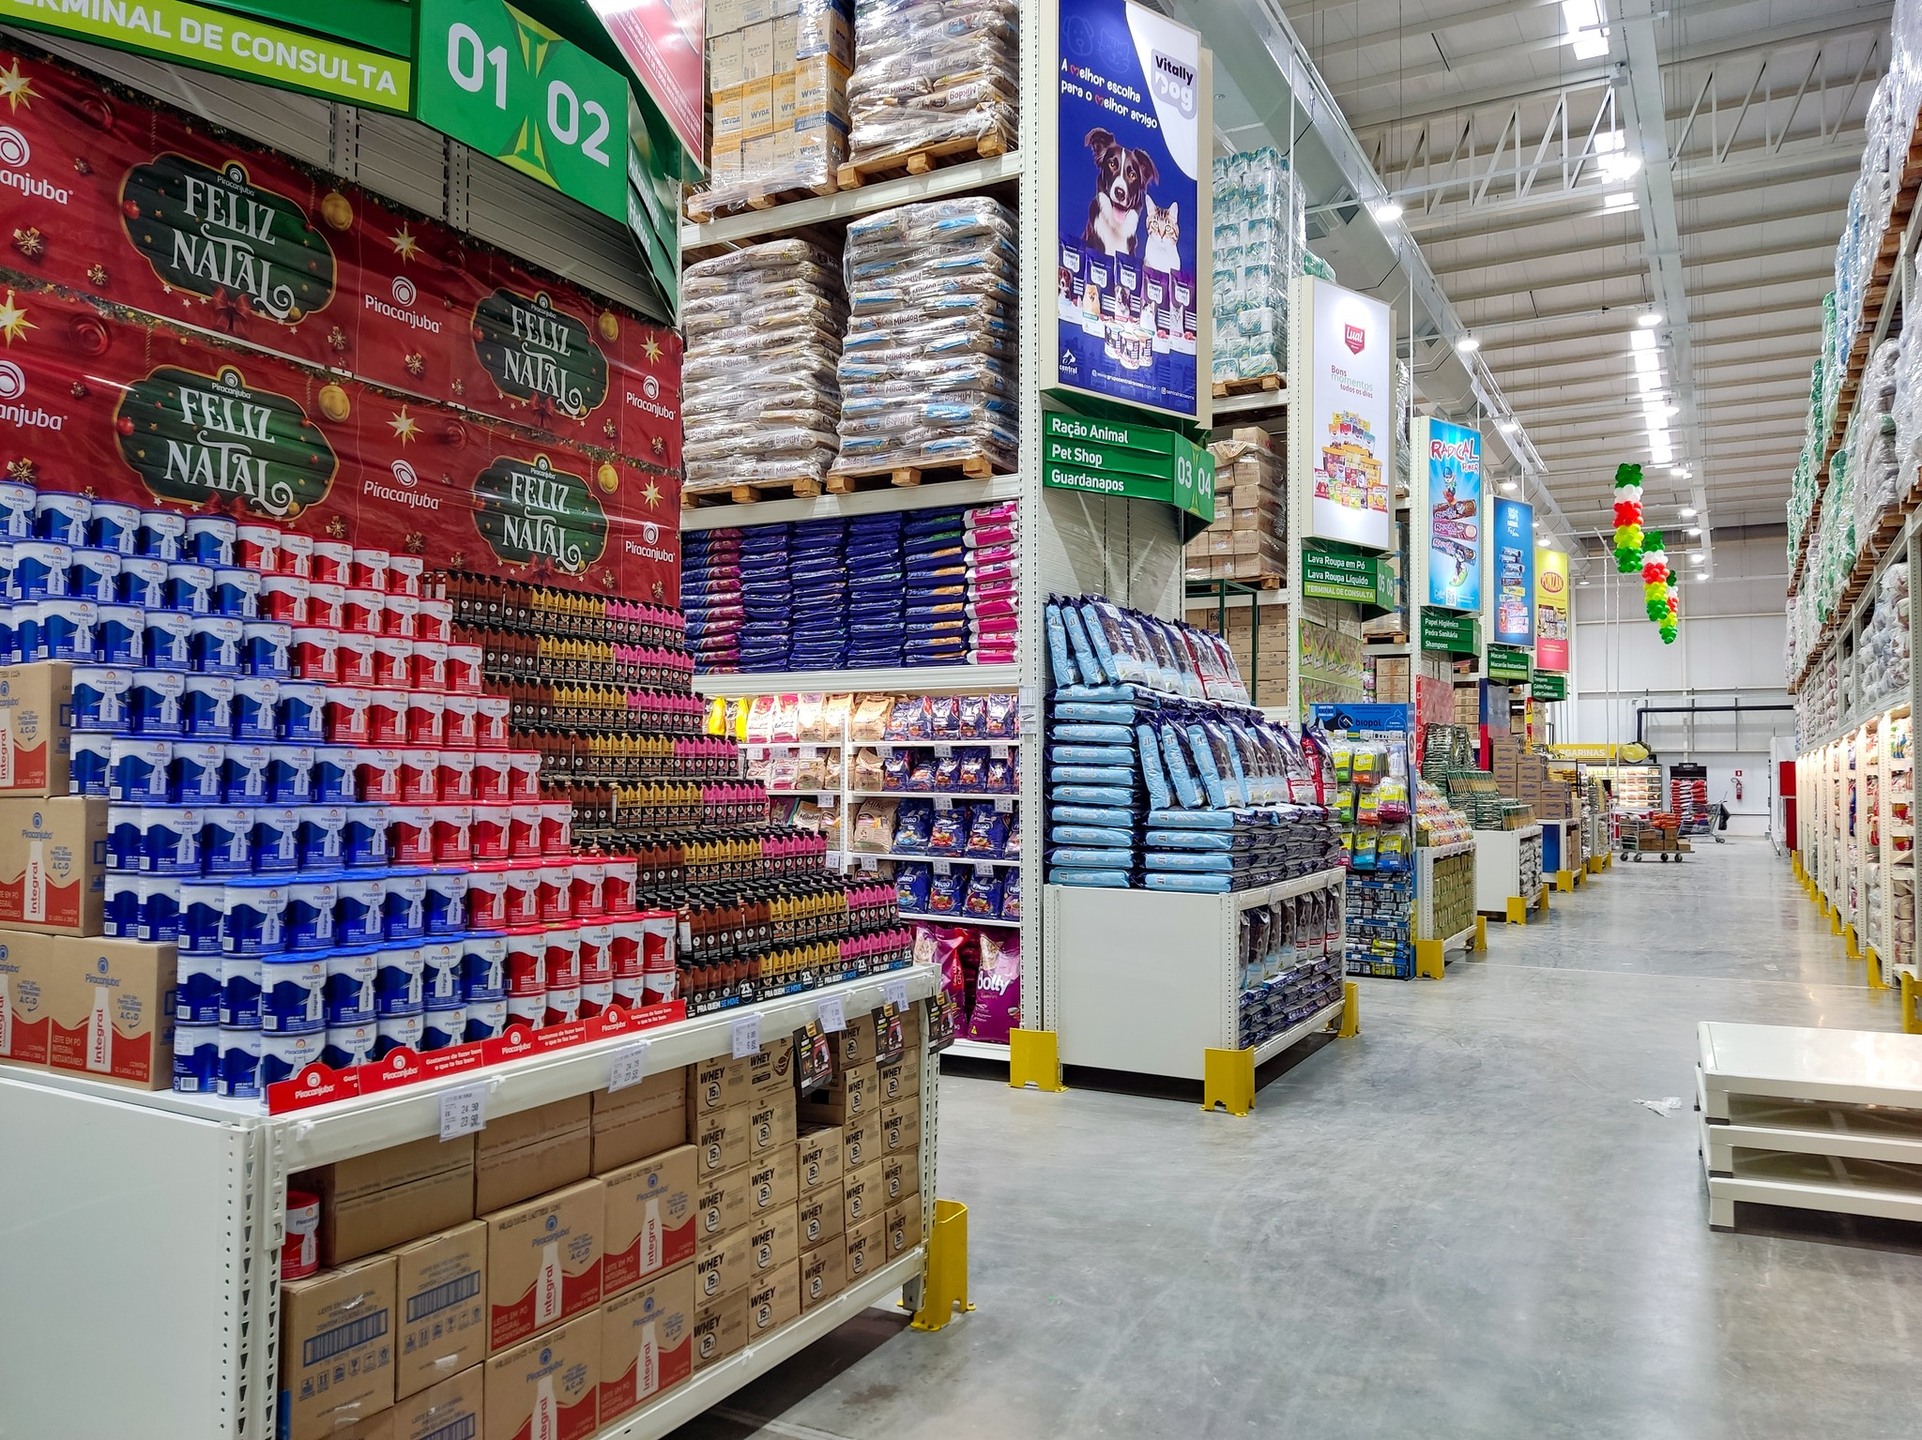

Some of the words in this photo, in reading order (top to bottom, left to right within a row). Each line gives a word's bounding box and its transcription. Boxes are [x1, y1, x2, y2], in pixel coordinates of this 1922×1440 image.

[180, 19, 223, 51] DE
[231, 32, 397, 96] CONSULTA
[447, 22, 508, 111] 01
[1155, 55, 1194, 86] Vitally
[1061, 58, 1068, 72] A
[1070, 63, 1105, 88] melhor
[1107, 80, 1141, 104] escolha
[750, 109, 770, 119] WYDA
[781, 103, 795, 112] WYD
[1061, 79, 1083, 98] para
[1085, 90, 1092, 101] o
[1094, 94, 1128, 117] melhor
[1130, 110, 1158, 129] amigo
[547, 79, 610, 169] 02
[183, 174, 276, 246] FELIZ
[171, 223, 295, 319] NATAL
[364, 294, 441, 334] Piracanjuba
[510, 303, 573, 358] FELIZ
[502, 341, 583, 416] NATAL
[1331, 364, 1347, 377] Bons
[211, 381, 252, 399] Piracanjuba
[1331, 373, 1373, 391] momentos
[1340, 383, 1355, 394] todos
[1363, 391, 1373, 399] dias
[178, 386, 276, 445] FELIZ
[626, 391, 676, 421] Piracanjuba
[1052, 417, 1088, 438] Ração
[1089, 424, 1129, 444] Animal
[1051, 443, 1072, 461] Pet
[1074, 448, 1103, 467] Shop
[1430, 438, 1479, 461] RADICAL
[162, 430, 295, 517] NATAL
[1051, 469, 1125, 493] Guardanapos
[1178, 456, 1192, 489] 03
[1198, 467, 1212, 499] 04
[363, 480, 440, 510] Piracanjuba
[508, 471, 572, 516] FELIZ
[502, 506, 582, 573] NATAL
[625, 541, 675, 563] Piracanjuba
[1308, 553, 1323, 564] Lava
[1325, 556, 1344, 567] Roupa
[1357, 560, 1365, 570] Pó
[1308, 569, 1323, 579] Lava
[1325, 572, 1344, 583] Roupa
[1346, 574, 1368, 585] Líquido
[1307, 585, 1335, 595] TERMINAL
[1345, 589, 1373, 599] CONSULTA
[1355, 718, 1381, 728] biopol
[22, 829, 53, 841] Piracanjuba
[85, 973, 120, 987] Piracanjuba
[727, 997, 740, 1006] MOVE
[602, 1020, 626, 1032] Piracanjuba
[52, 1035, 65, 1045] LEITE
[65, 1037, 73, 1045] EM
[52, 1045, 74, 1055] INTEGRAL
[502, 1043, 533, 1056] Piracanjuba
[52, 1054, 84, 1067] INSTANTÂNEO
[426, 1055, 450, 1066] Gostamos
[458, 1051, 470, 1059] fazer
[471, 1048, 482, 1056] bem
[439, 1063, 449, 1071] que
[464, 1057, 475, 1065] bem
[382, 1067, 419, 1081] Piracanjuba
[700, 1067, 725, 1085] WHEY
[883, 1066, 903, 1080] WHEY
[295, 1084, 335, 1099] Piracanjuba
[752, 1108, 775, 1126] WHEY
[701, 1127, 725, 1147] WHEY
[802, 1148, 824, 1166] WHEY
[531, 1227, 570, 1248] Piracanjuba
[751, 1227, 776, 1247] WHEY
[849, 1237, 867, 1254] WHEY
[698, 1253, 725, 1274] WHEY
